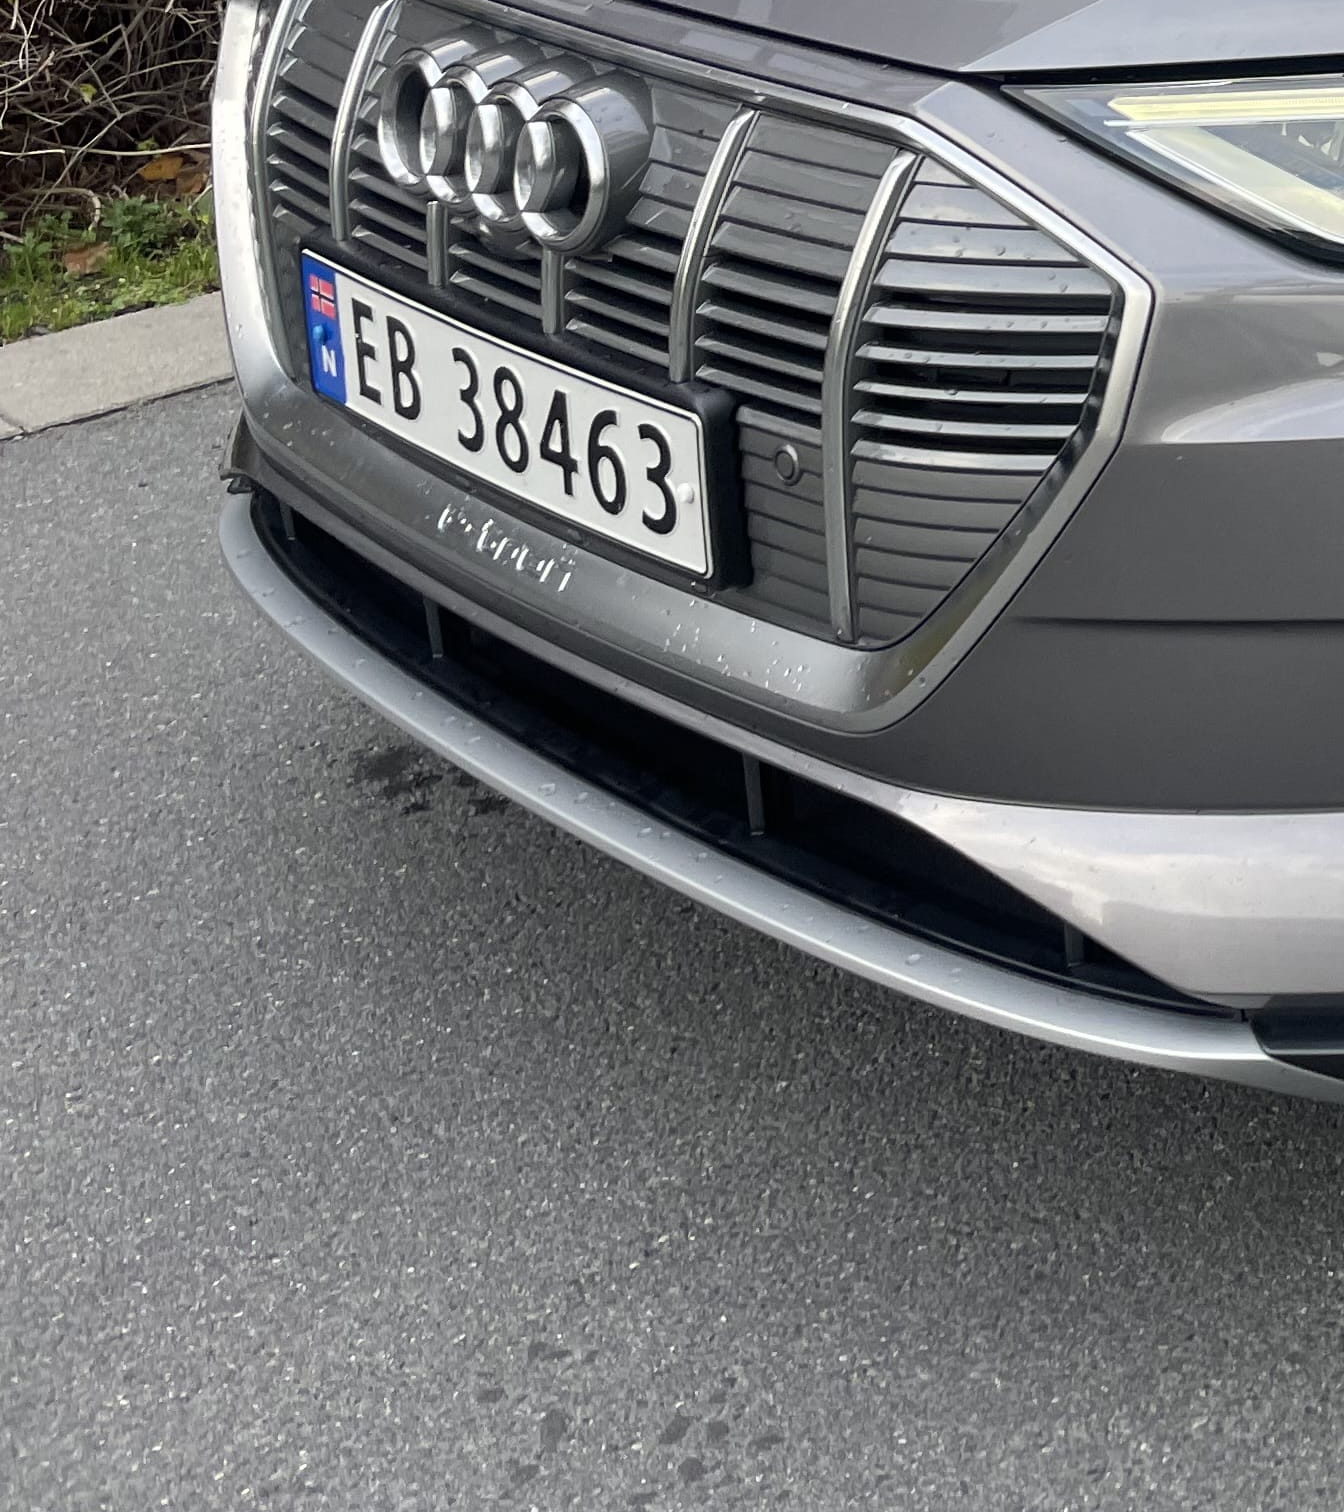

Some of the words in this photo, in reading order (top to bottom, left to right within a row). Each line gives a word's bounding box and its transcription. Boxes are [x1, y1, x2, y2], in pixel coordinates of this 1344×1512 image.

[321, 345, 338, 377] N
[353, 298, 421, 420] EB
[453, 348, 677, 535] 38463
